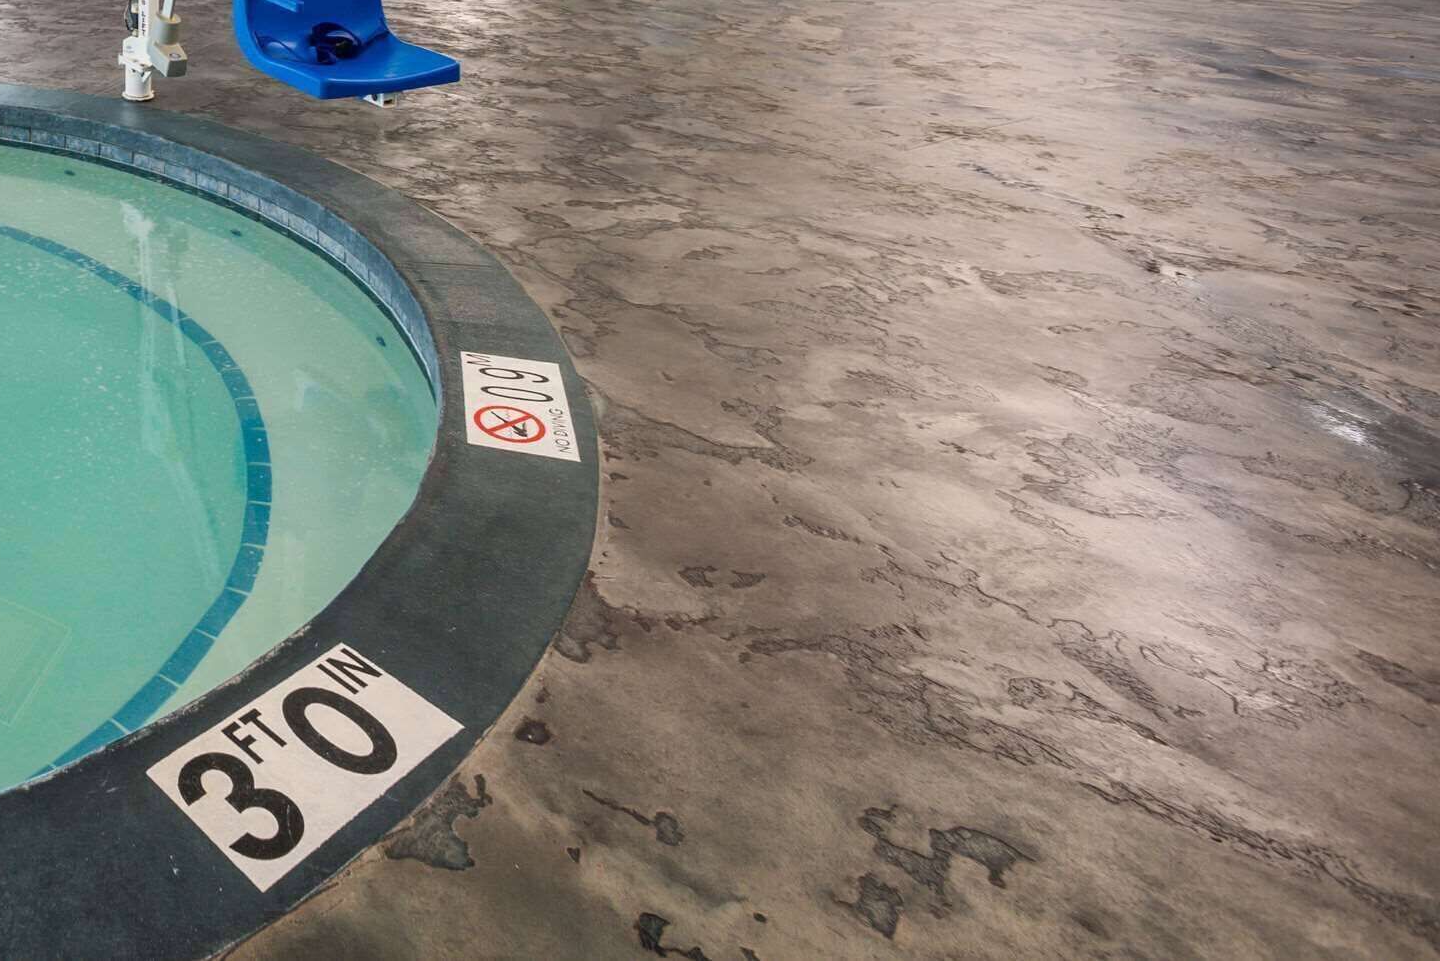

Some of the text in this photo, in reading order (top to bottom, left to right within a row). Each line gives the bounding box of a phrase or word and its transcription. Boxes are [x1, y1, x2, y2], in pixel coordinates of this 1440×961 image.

[465, 353, 492, 367] M
[548, 408, 572, 454] NO DIVING
[177, 647, 398, 861] 3 FT 0 IN
